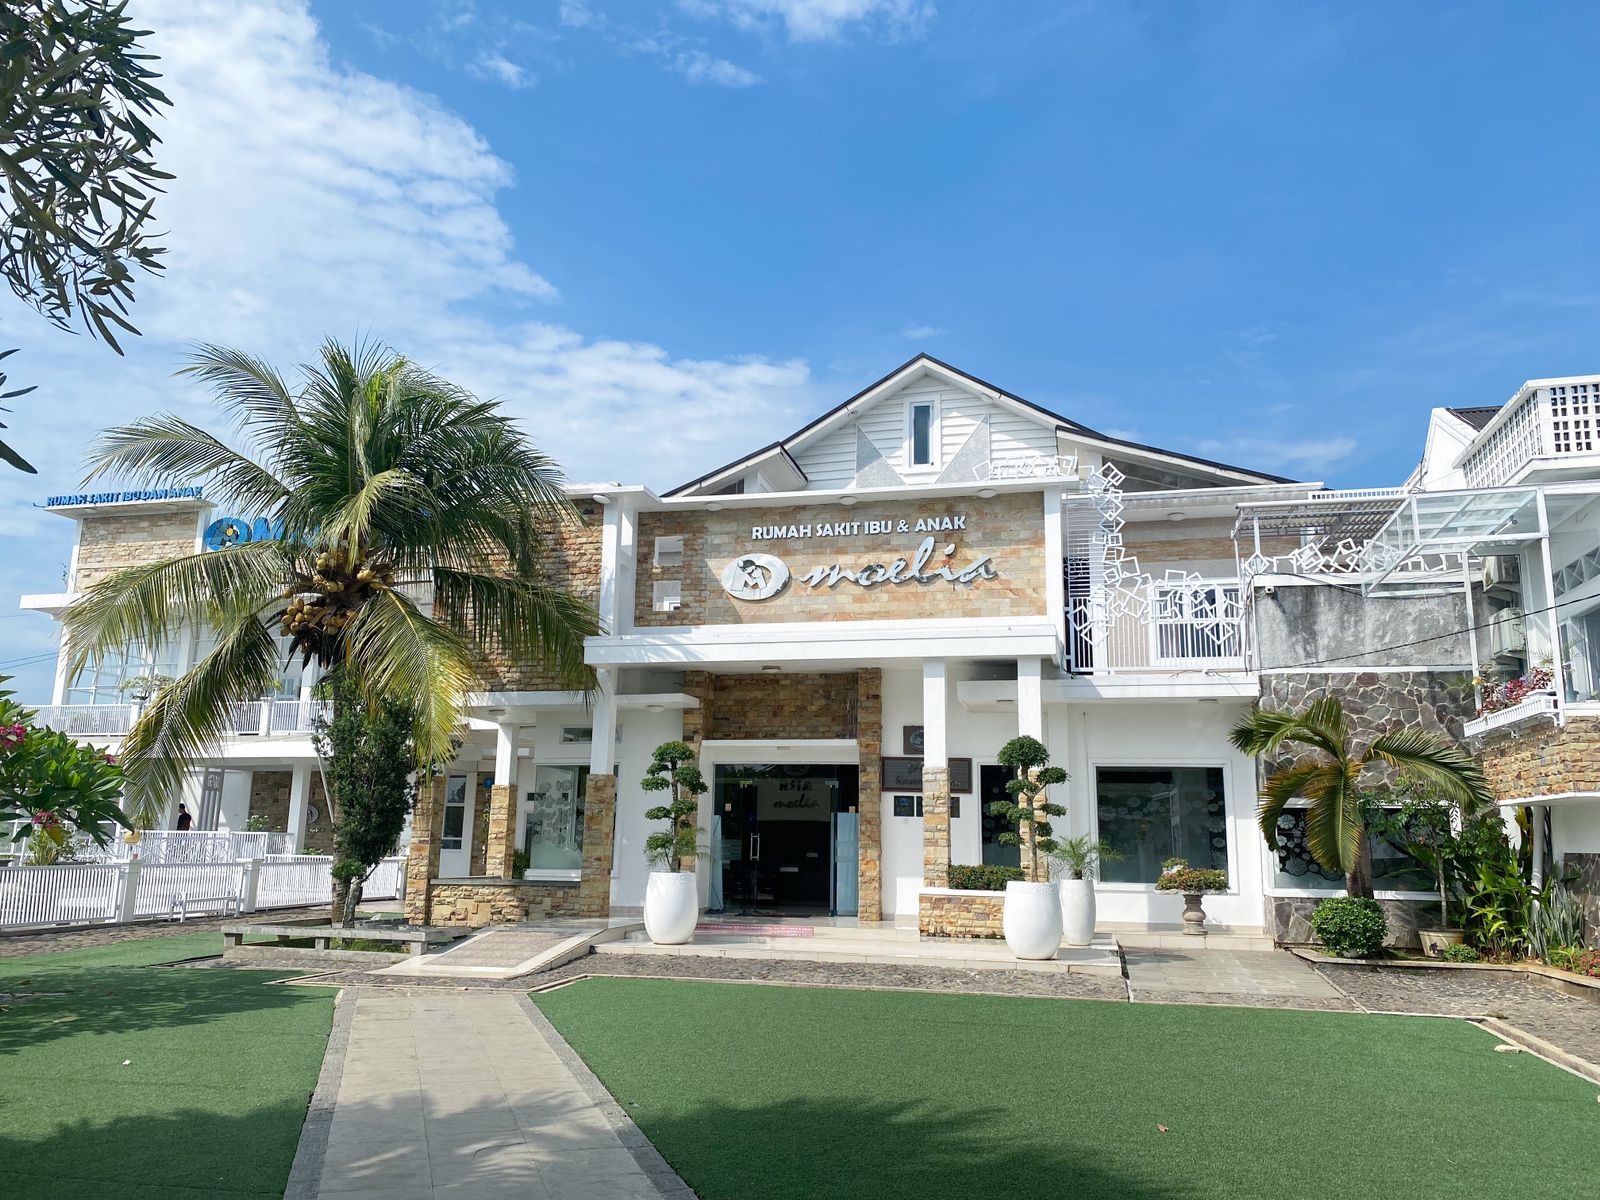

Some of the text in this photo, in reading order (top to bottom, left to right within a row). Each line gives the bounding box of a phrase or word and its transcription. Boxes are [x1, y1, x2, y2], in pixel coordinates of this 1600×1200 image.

[47, 494, 87, 507] RUMAH
[88, 492, 121, 505] SAKIT
[122, 490, 142, 502] IBU
[143, 489, 167, 501] DAN
[752, 515, 966, 540] RUMAH SAKIT IBU & ANAK
